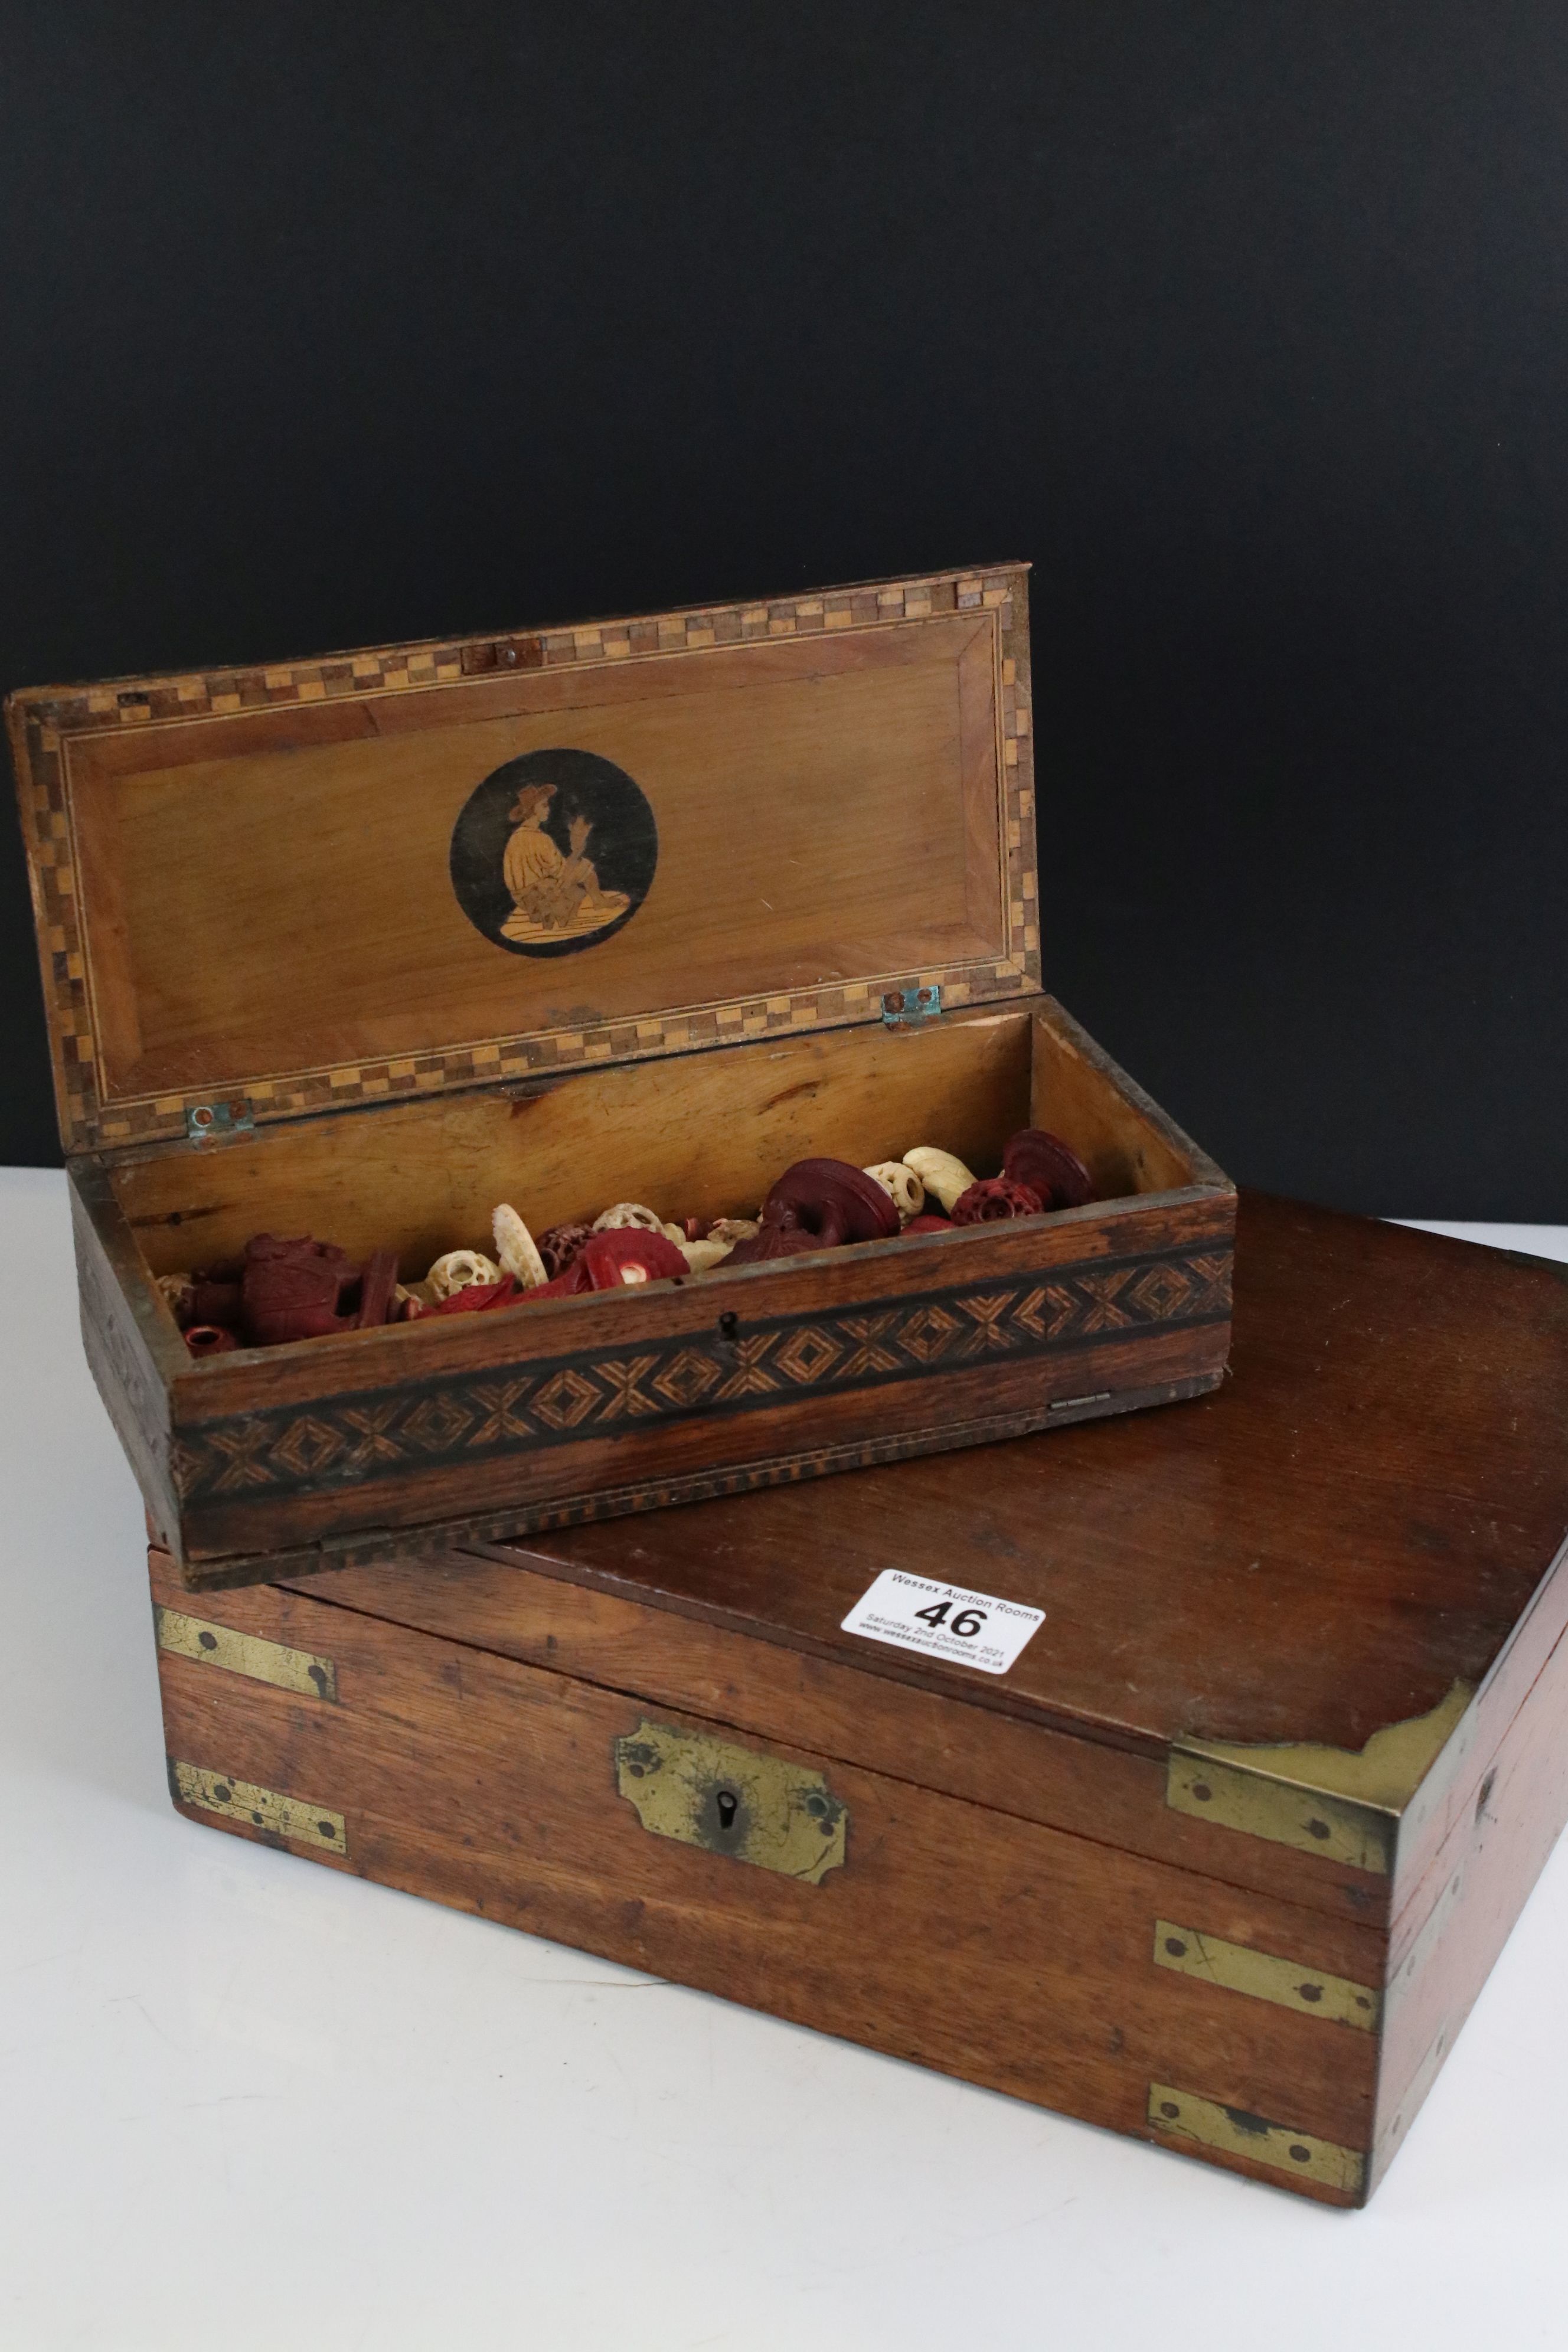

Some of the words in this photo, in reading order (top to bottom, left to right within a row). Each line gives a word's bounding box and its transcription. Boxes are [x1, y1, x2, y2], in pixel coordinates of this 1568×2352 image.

[891, 1573, 940, 1593] Wessex
[943, 1589, 992, 1609] Auction
[995, 1603, 1040, 1622] Rooms
[914, 1601, 988, 1637] 46
[858, 1622, 1003, 1667] www.wessexauctionrooms.co.uk
[867, 1613, 912, 1633] Saturday
[914, 1627, 935, 1638] 2nd
[937, 1634, 978, 1650] October
[980, 1646, 1004, 1658] 2021
